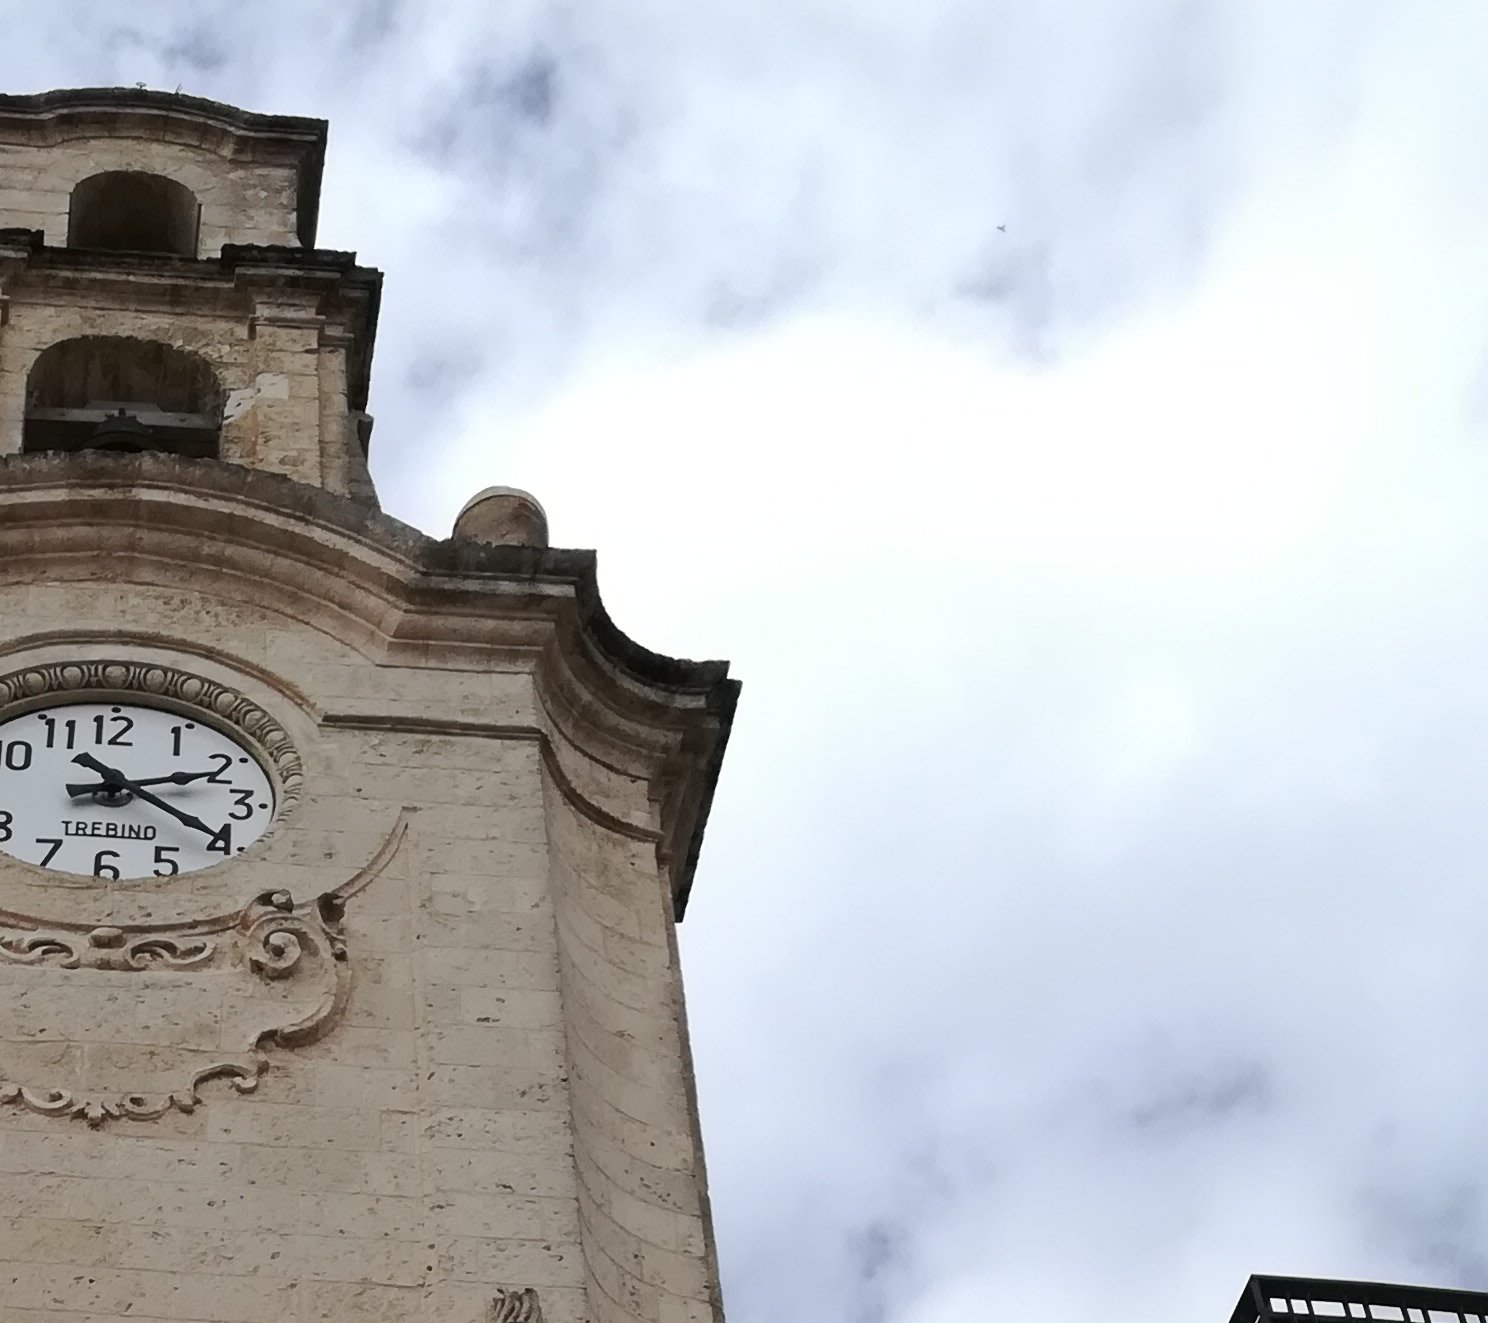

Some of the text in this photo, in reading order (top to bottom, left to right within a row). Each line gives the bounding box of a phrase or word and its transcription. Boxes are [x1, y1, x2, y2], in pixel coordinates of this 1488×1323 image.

[45, 718, 76, 749] 11
[94, 714, 134, 746] 12
[171, 726, 181, 756] 1
[207, 753, 233, 785] 2
[228, 789, 253, 820] 3
[62, 820, 157, 840] TREBINO
[206, 823, 231, 856] 4
[35, 838, 63, 867] 7
[94, 850, 120, 881] 6
[153, 846, 179, 877] 5
